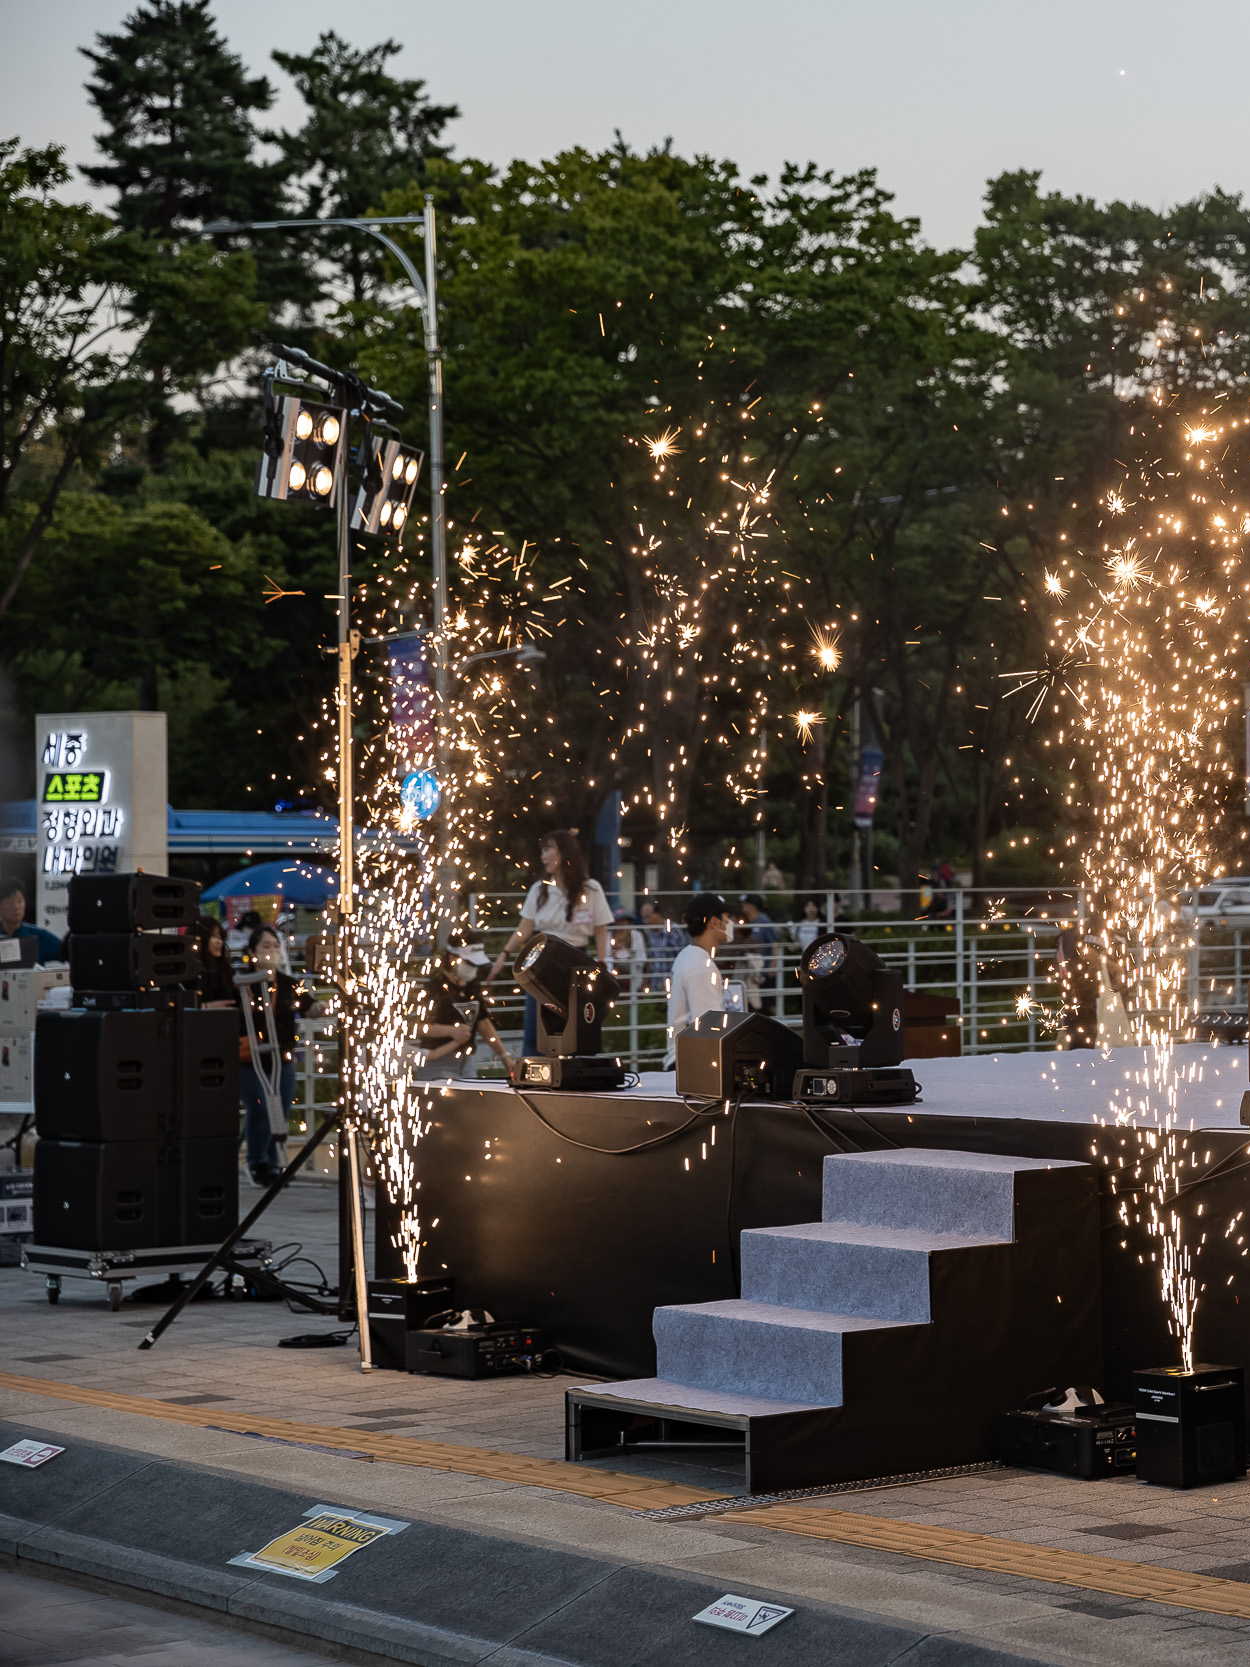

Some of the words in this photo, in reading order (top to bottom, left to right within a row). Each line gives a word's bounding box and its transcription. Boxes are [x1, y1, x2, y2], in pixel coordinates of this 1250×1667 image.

[43, 732, 88, 768] 세종
[45, 773, 101, 800] 스포츠
[41, 808, 124, 843] 정형외과
[308, 1518, 377, 1543] WARNING
[321, 1541, 344, 1551] 주의
